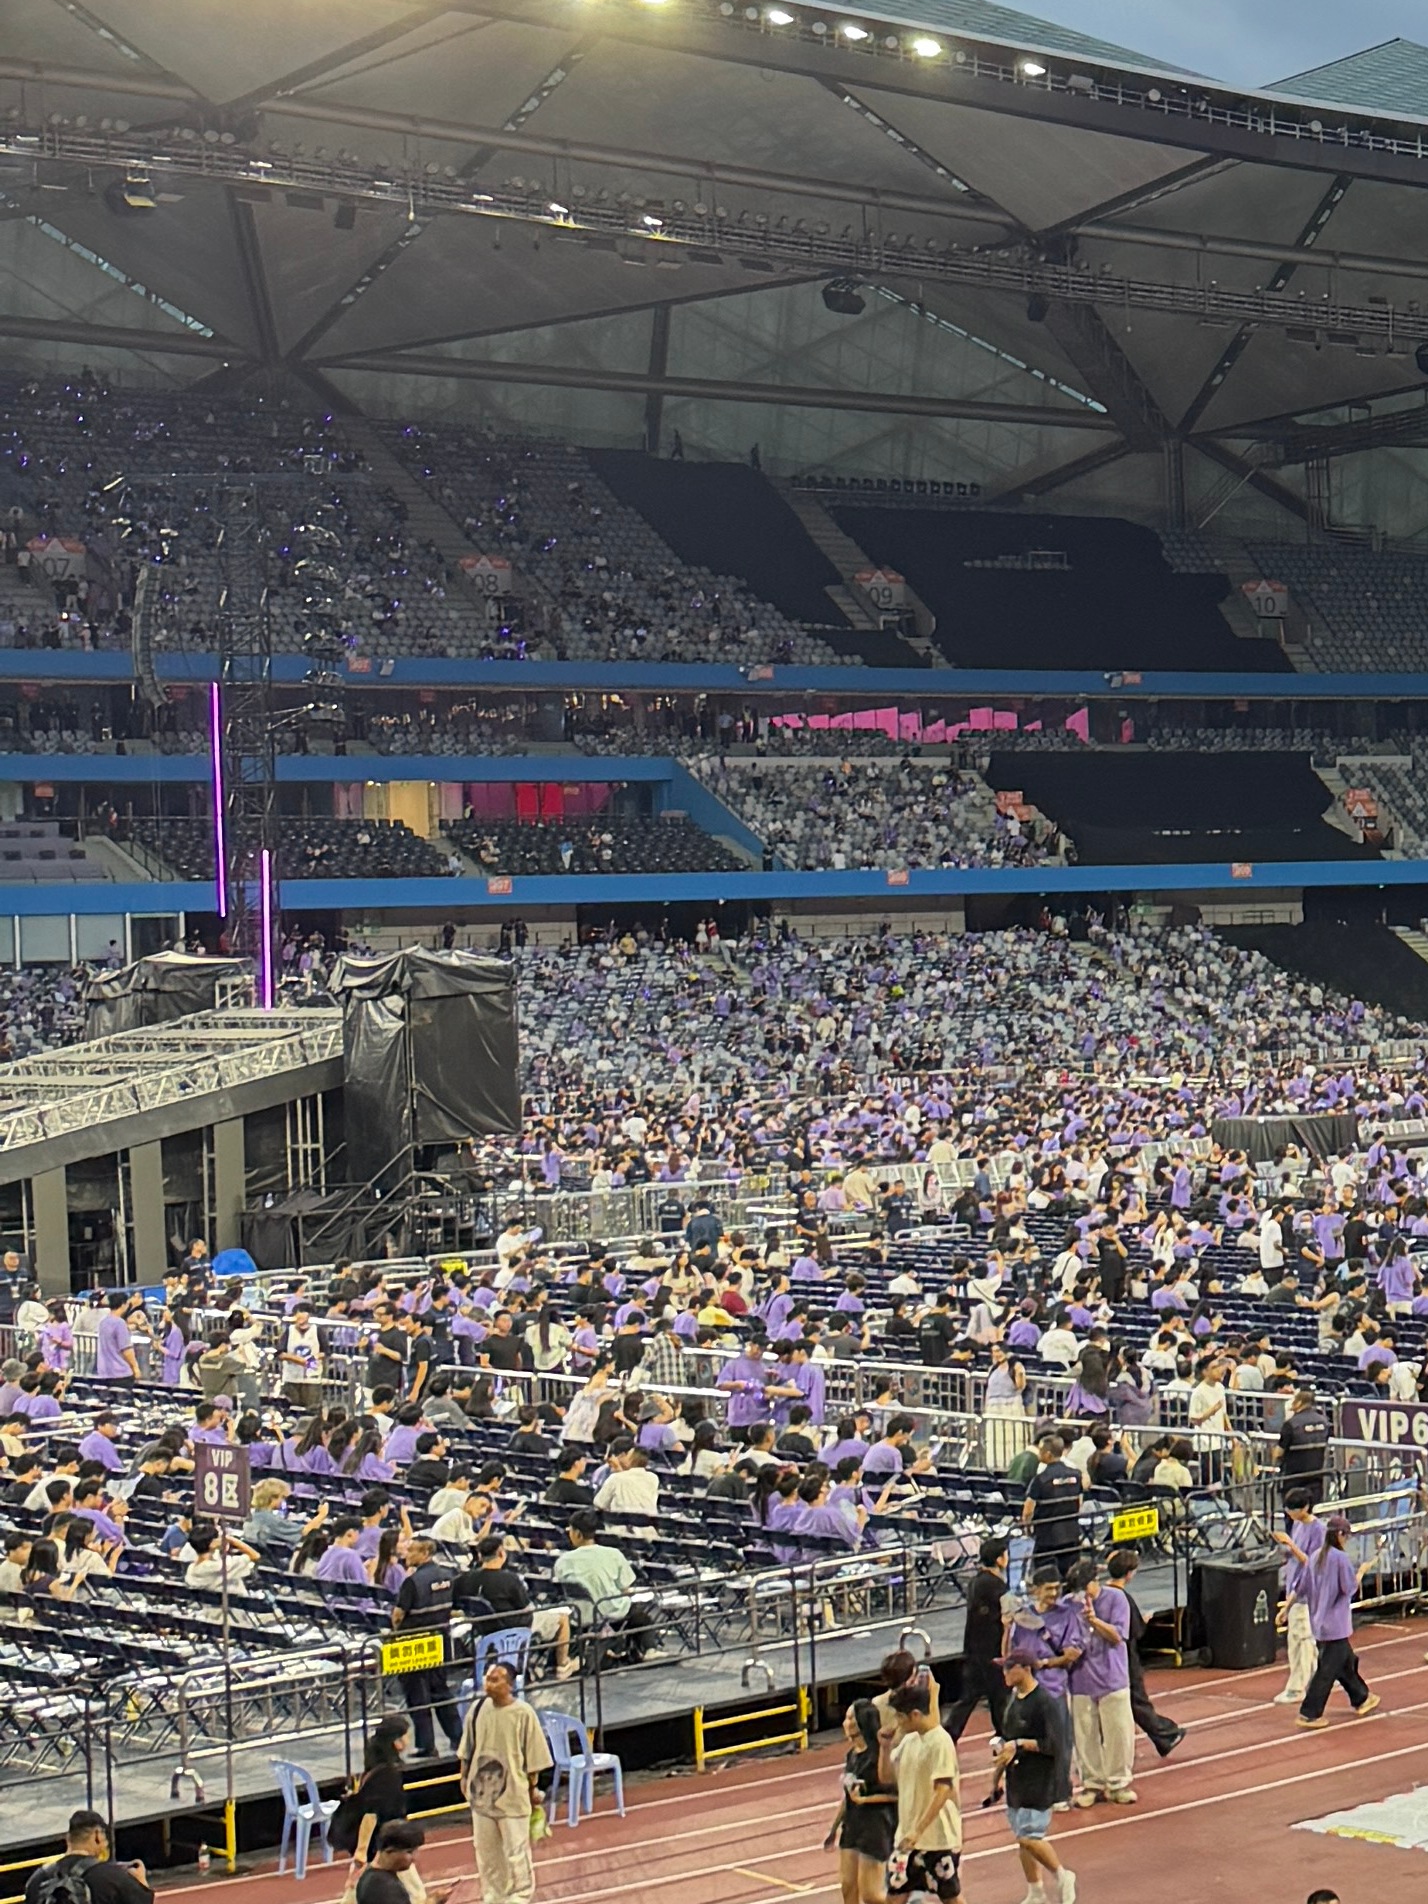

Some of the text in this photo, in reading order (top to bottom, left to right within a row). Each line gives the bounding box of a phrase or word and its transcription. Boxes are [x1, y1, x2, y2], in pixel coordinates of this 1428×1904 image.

[870, 586, 892, 605] 09
[1256, 596, 1276, 614] 10
[211, 1448, 233, 1468] VIP
[204, 1471, 240, 1509] 8区
